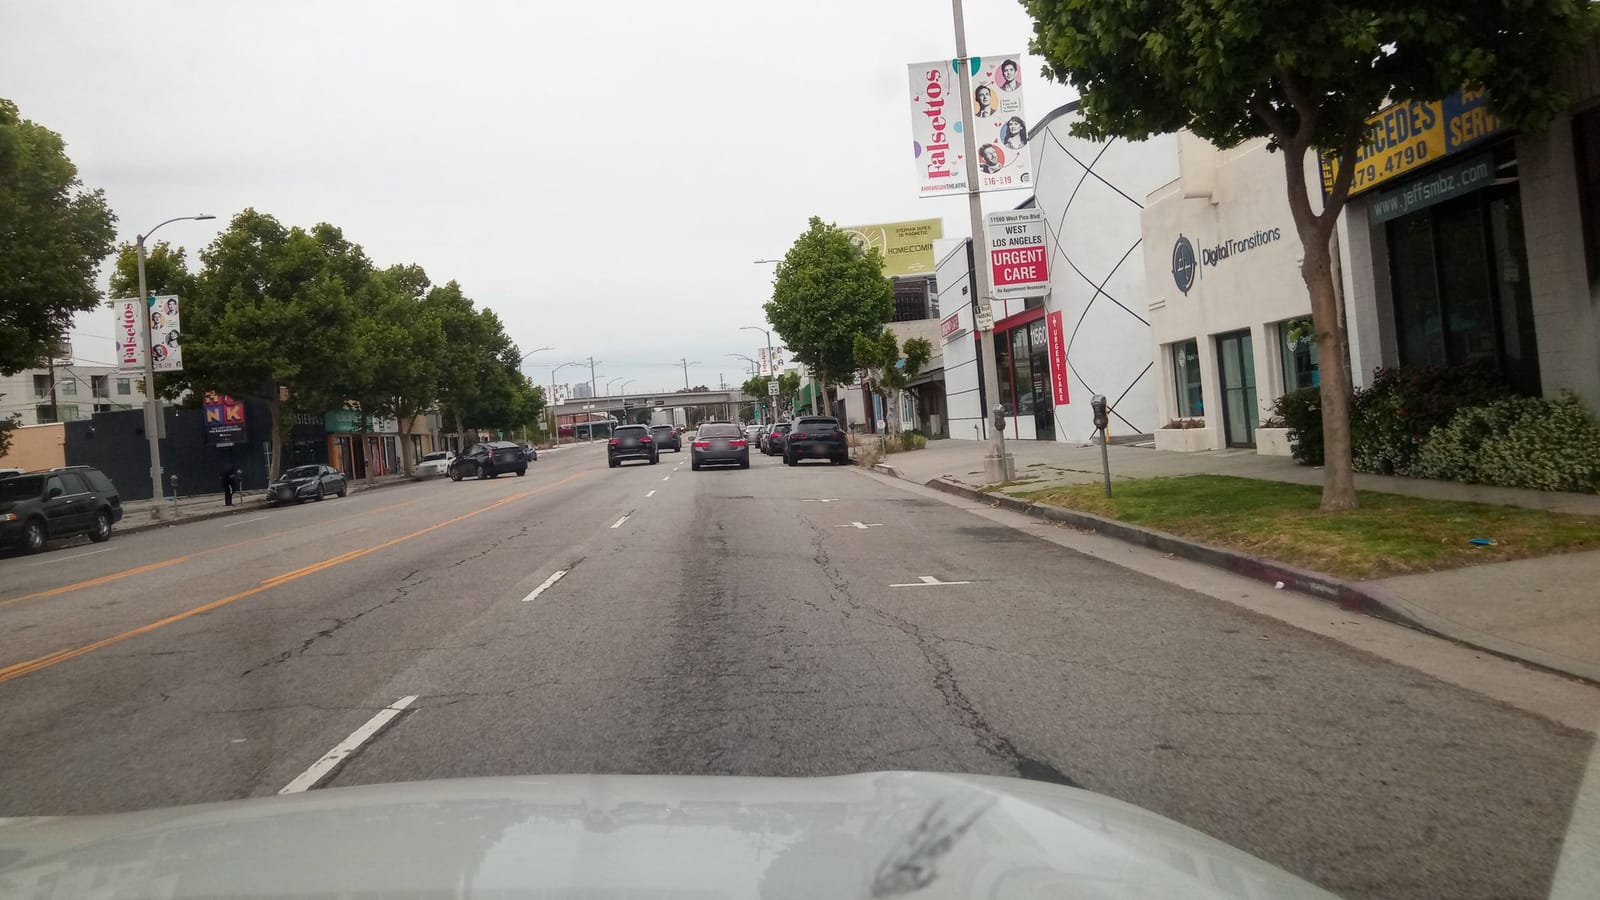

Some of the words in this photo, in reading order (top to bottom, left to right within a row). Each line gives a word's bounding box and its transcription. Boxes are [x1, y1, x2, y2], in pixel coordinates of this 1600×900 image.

[923, 69, 950, 179] Falsettos
[1373, 162, 1488, 216] www.jeffsmbz.com
[992, 238, 1007, 248] LOS
[1009, 235, 1042, 246] ANGELES
[1005, 225, 1026, 235] WEST
[993, 249, 1044, 266] URGENT
[1202, 226, 1281, 267] DigitalTransitions
[1004, 266, 1037, 281] CARE
[122, 303, 137, 363] Falsettos
[1057, 374, 1065, 402] CARE
